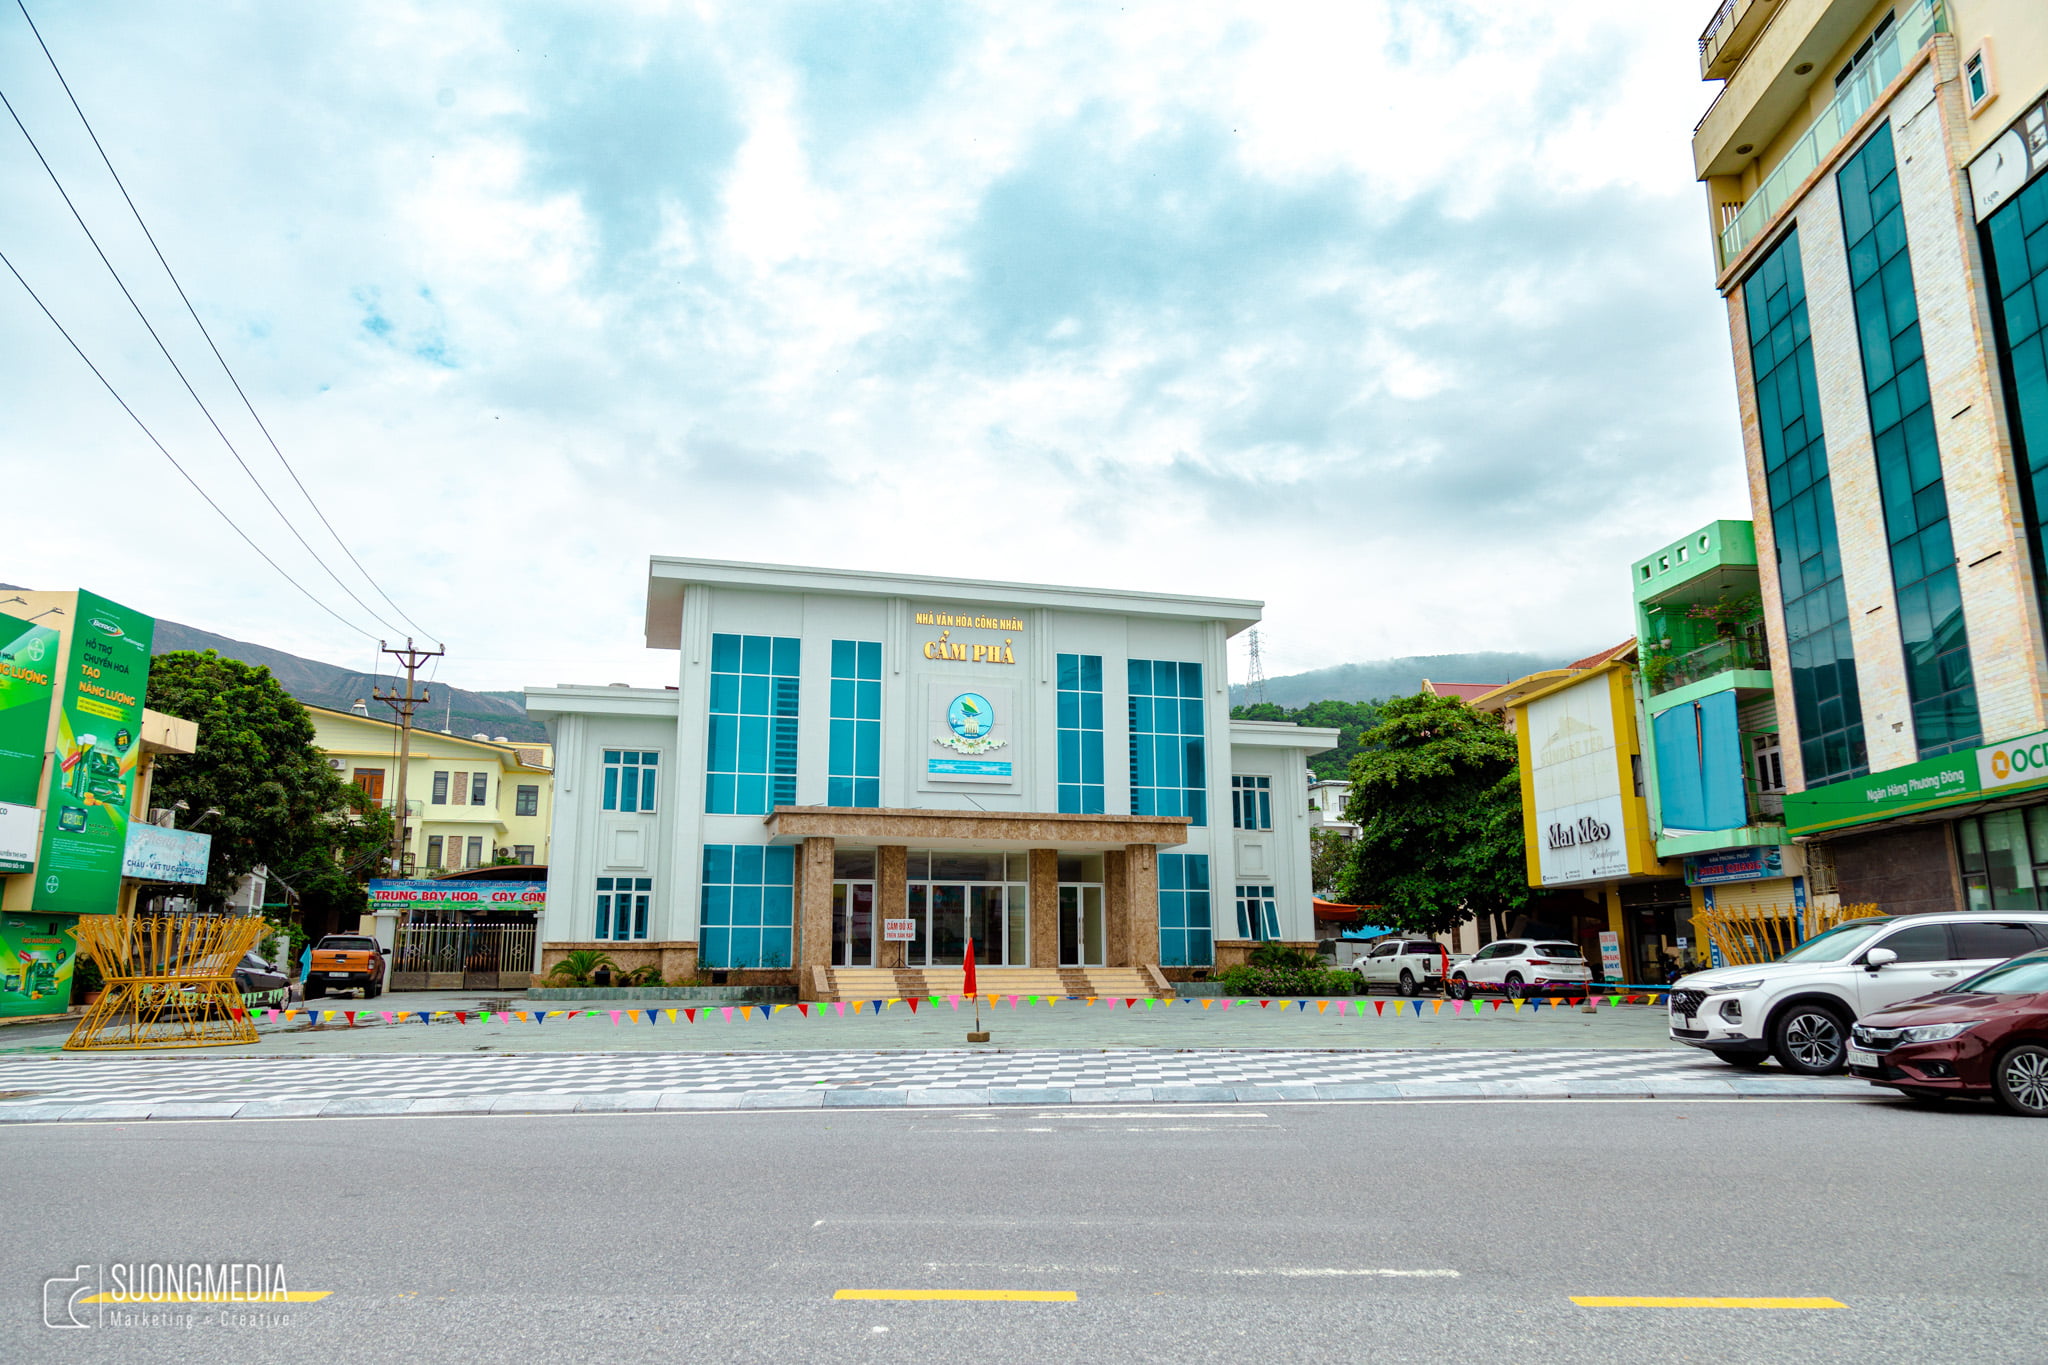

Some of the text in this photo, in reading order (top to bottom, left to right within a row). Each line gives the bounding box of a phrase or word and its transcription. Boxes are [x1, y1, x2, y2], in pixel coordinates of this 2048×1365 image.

[916, 610, 1023, 632] NHÀ VĂN HÓA CÔNG NHÂN
[924, 630, 1015, 664] CẨM PHẢ
[11, 665, 48, 686] LƯỢNG
[81, 664, 100, 679] TẠO
[78, 681, 136, 707] NĂNG LƯỢNG
[1866, 788, 1887, 803] Ngân
[1887, 783, 1908, 797] Hàng
[1940, 769, 1965, 785] Đông
[1549, 817, 1611, 850] Mai Mèo
[375, 890, 418, 901] TRUNG
[451, 890, 479, 902] HOA
